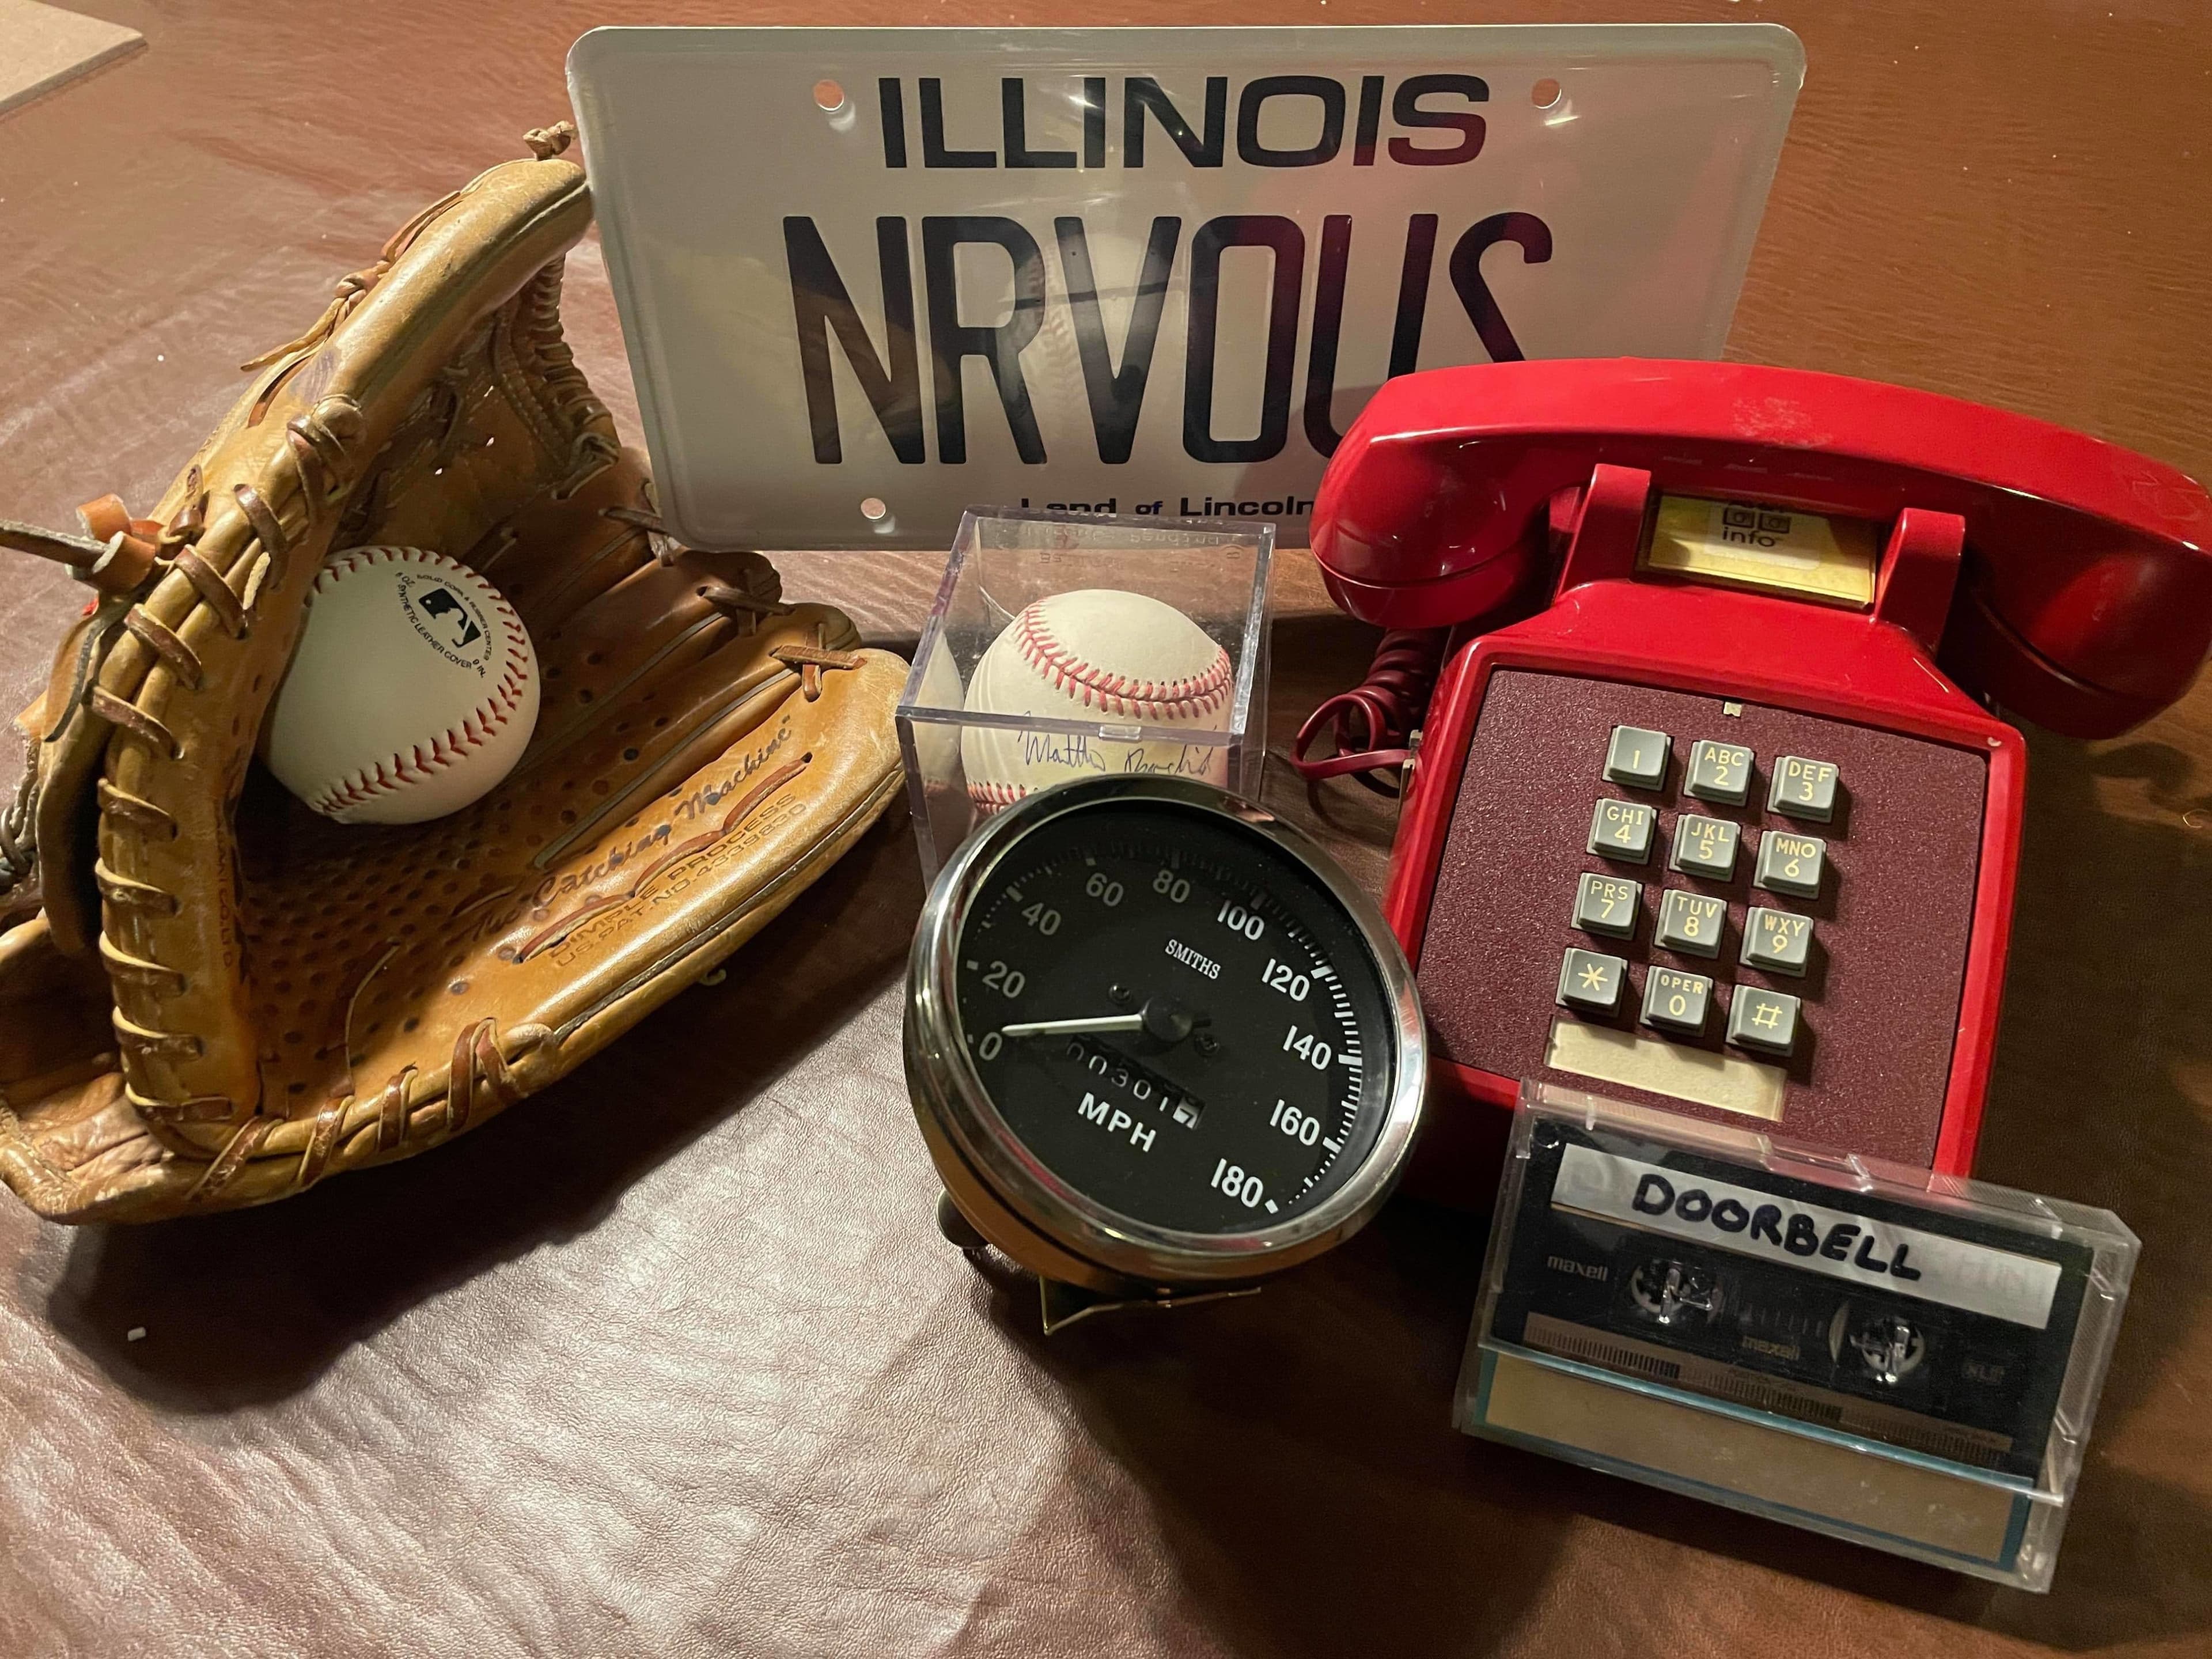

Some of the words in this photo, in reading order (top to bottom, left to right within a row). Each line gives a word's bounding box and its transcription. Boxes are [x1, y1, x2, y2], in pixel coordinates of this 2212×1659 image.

[878, 74, 1489, 168] ILLINOIS
[783, 212, 1552, 464] NRVOUS
[1135, 501, 1163, 515] of
[1722, 527, 1775, 547] info
[398, 584, 419, 623] SYNTHETIC
[415, 623, 445, 654] LEATHER
[444, 650, 472, 669] COVER
[1632, 749, 1640, 770] 1
[1705, 747, 1745, 767] ABC
[1715, 766, 1729, 786] 2
[1788, 761, 1832, 782] DEF
[1799, 781, 1813, 802] 3
[1607, 806, 1643, 825] GHI
[1614, 824, 1631, 843] 4
[1691, 822, 1730, 842] JKL
[1699, 840, 1713, 859] 5
[1775, 838, 1816, 858] MNO
[531, 824, 672, 908] Catching
[550, 885, 658, 958] DIMPLE
[668, 794, 796, 880] PROCESS
[1785, 859, 1800, 877] 6
[1085, 872, 1124, 907] 60
[1153, 869, 1191, 903] 80
[1590, 880, 1628, 901] PRS
[1021, 902, 1062, 936] 40
[1601, 899, 1614, 919] 7
[1677, 896, 1718, 919] TUV
[1217, 900, 1265, 941] 100
[1684, 916, 1699, 937] 8
[1764, 914, 1805, 938] WXY
[1772, 935, 1787, 953] 9
[1165, 938, 1221, 980] SMITHS
[982, 960, 1026, 999] 20
[1262, 959, 1310, 1001] 120
[1660, 975, 1703, 994] OPER
[1669, 995, 1685, 1016] 0
[978, 1032, 1003, 1060] 0
[1283, 1025, 1331, 1071] 140
[1078, 1092, 1156, 1152] MPH
[1270, 1100, 1320, 1146] 160
[1211, 1158, 1263, 1209] 180
[1633, 1173, 1921, 1282] DOORBELL
[1547, 1256, 1608, 1281] maxell
